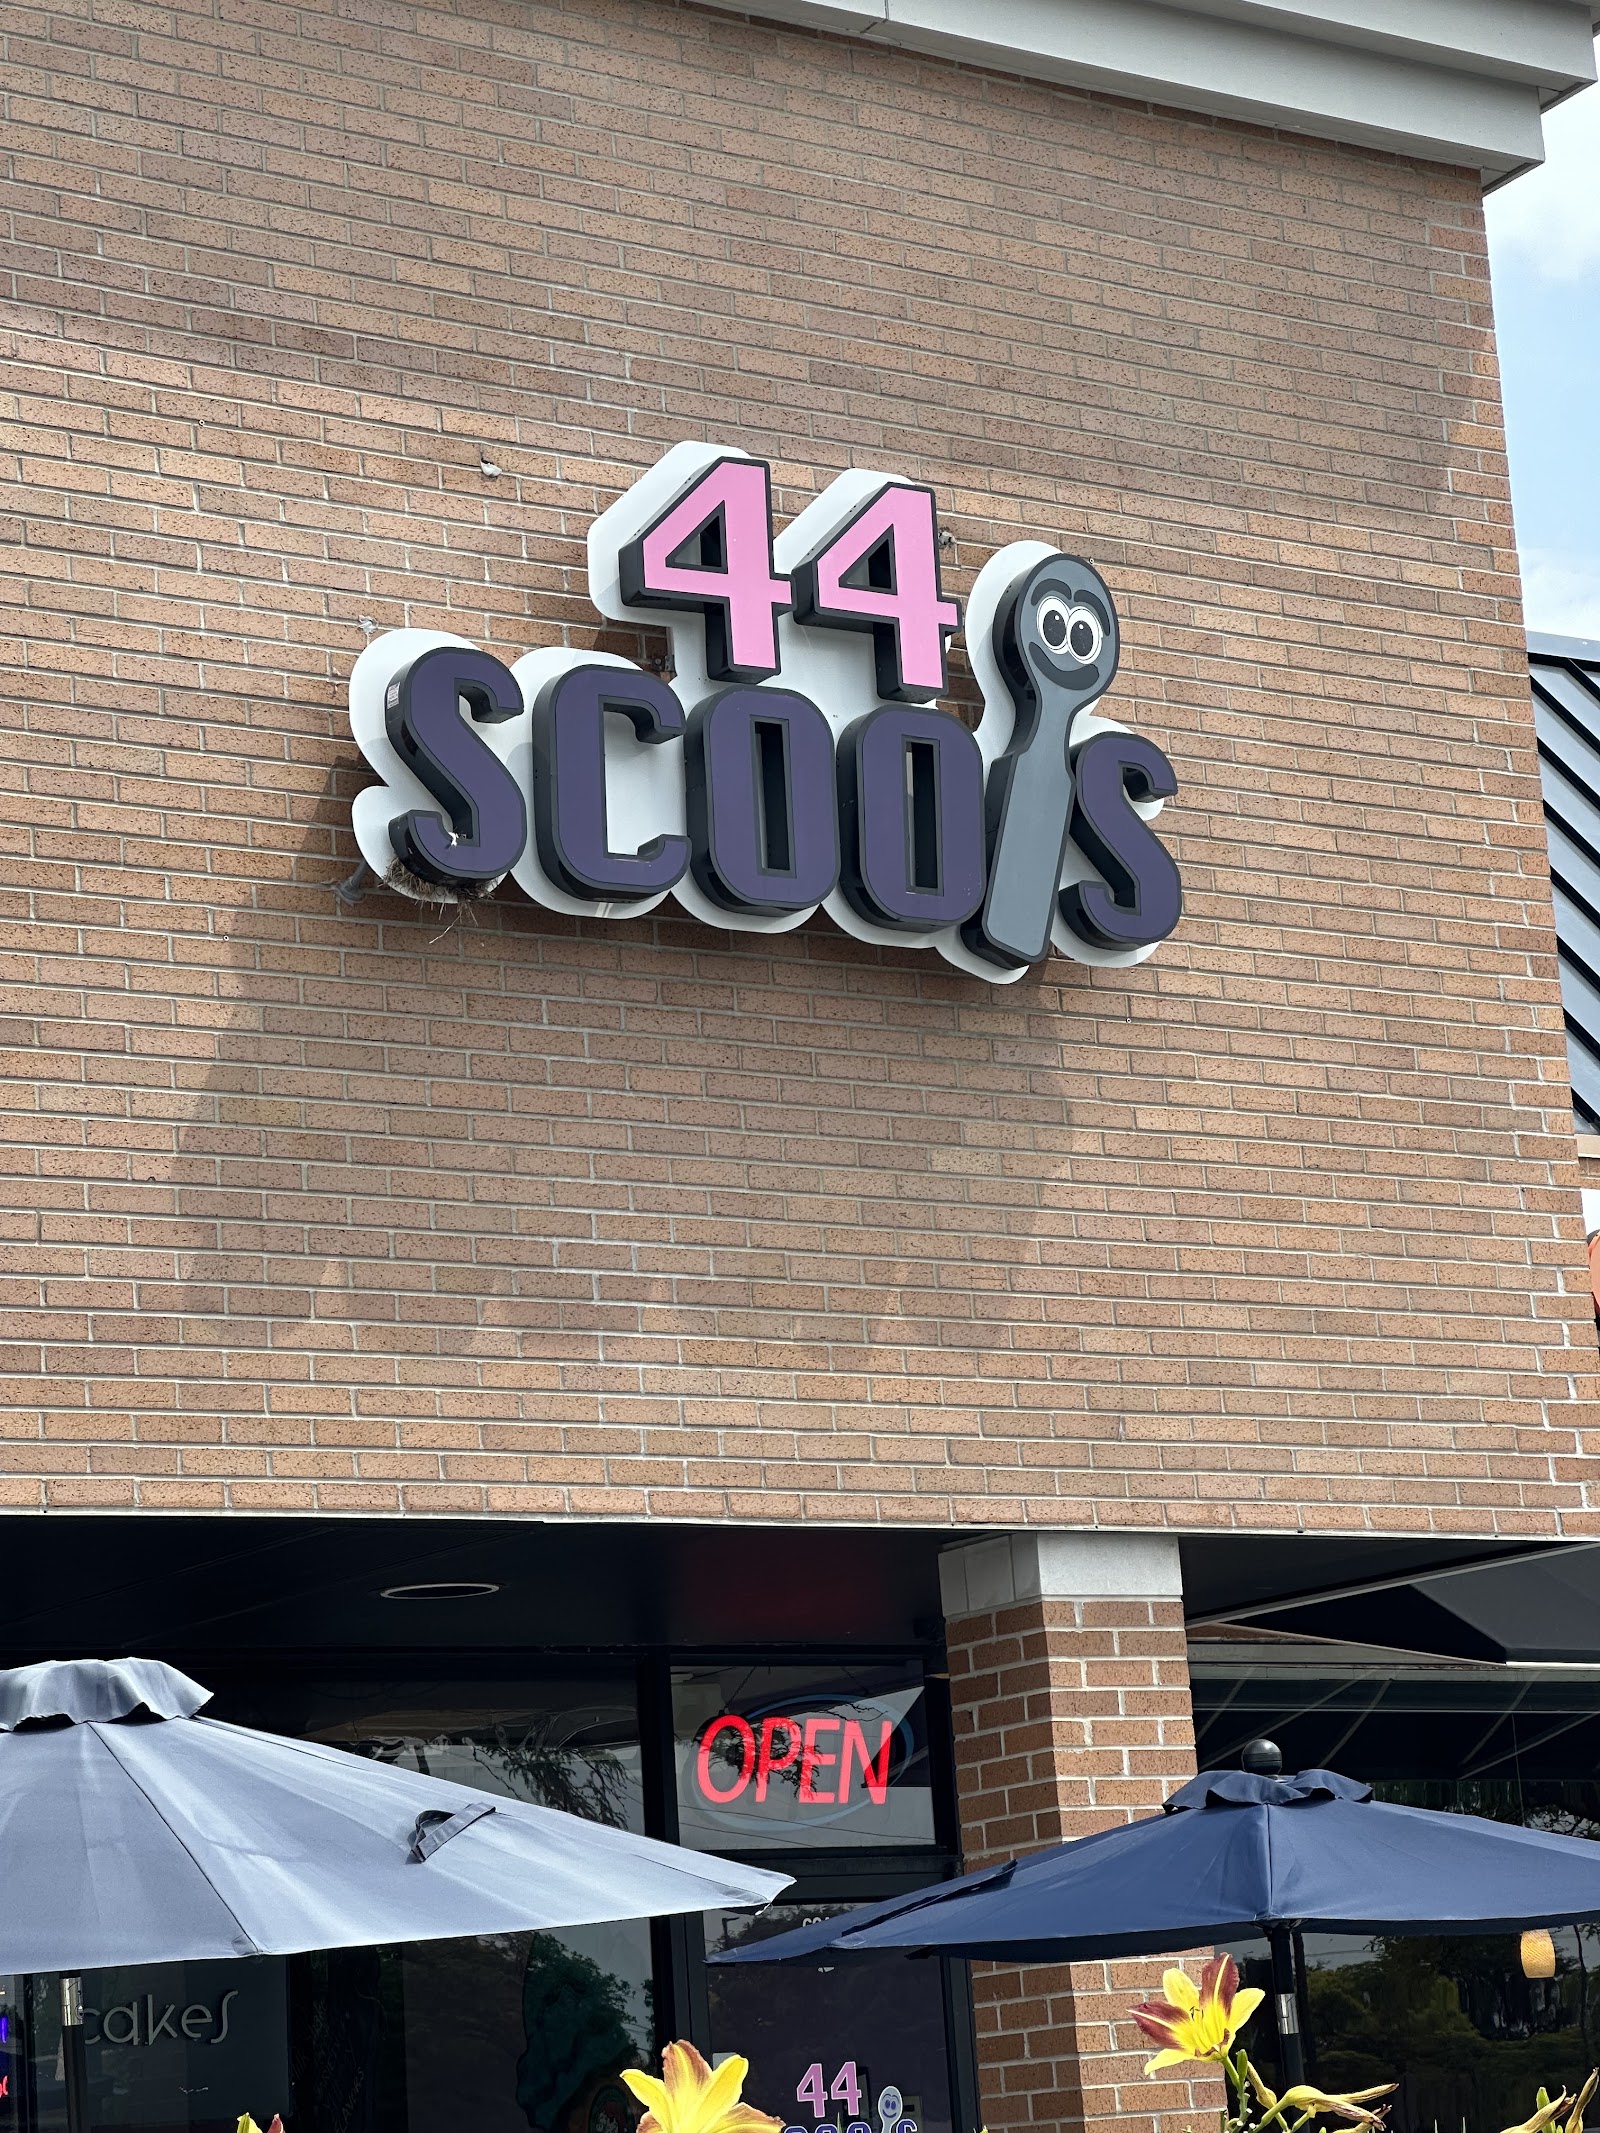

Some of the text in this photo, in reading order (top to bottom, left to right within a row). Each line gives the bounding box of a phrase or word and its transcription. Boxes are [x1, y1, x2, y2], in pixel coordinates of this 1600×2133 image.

[620, 456, 962, 703] 44
[697, 1714, 893, 1804] OPEN
[796, 2061, 862, 2118] 44
